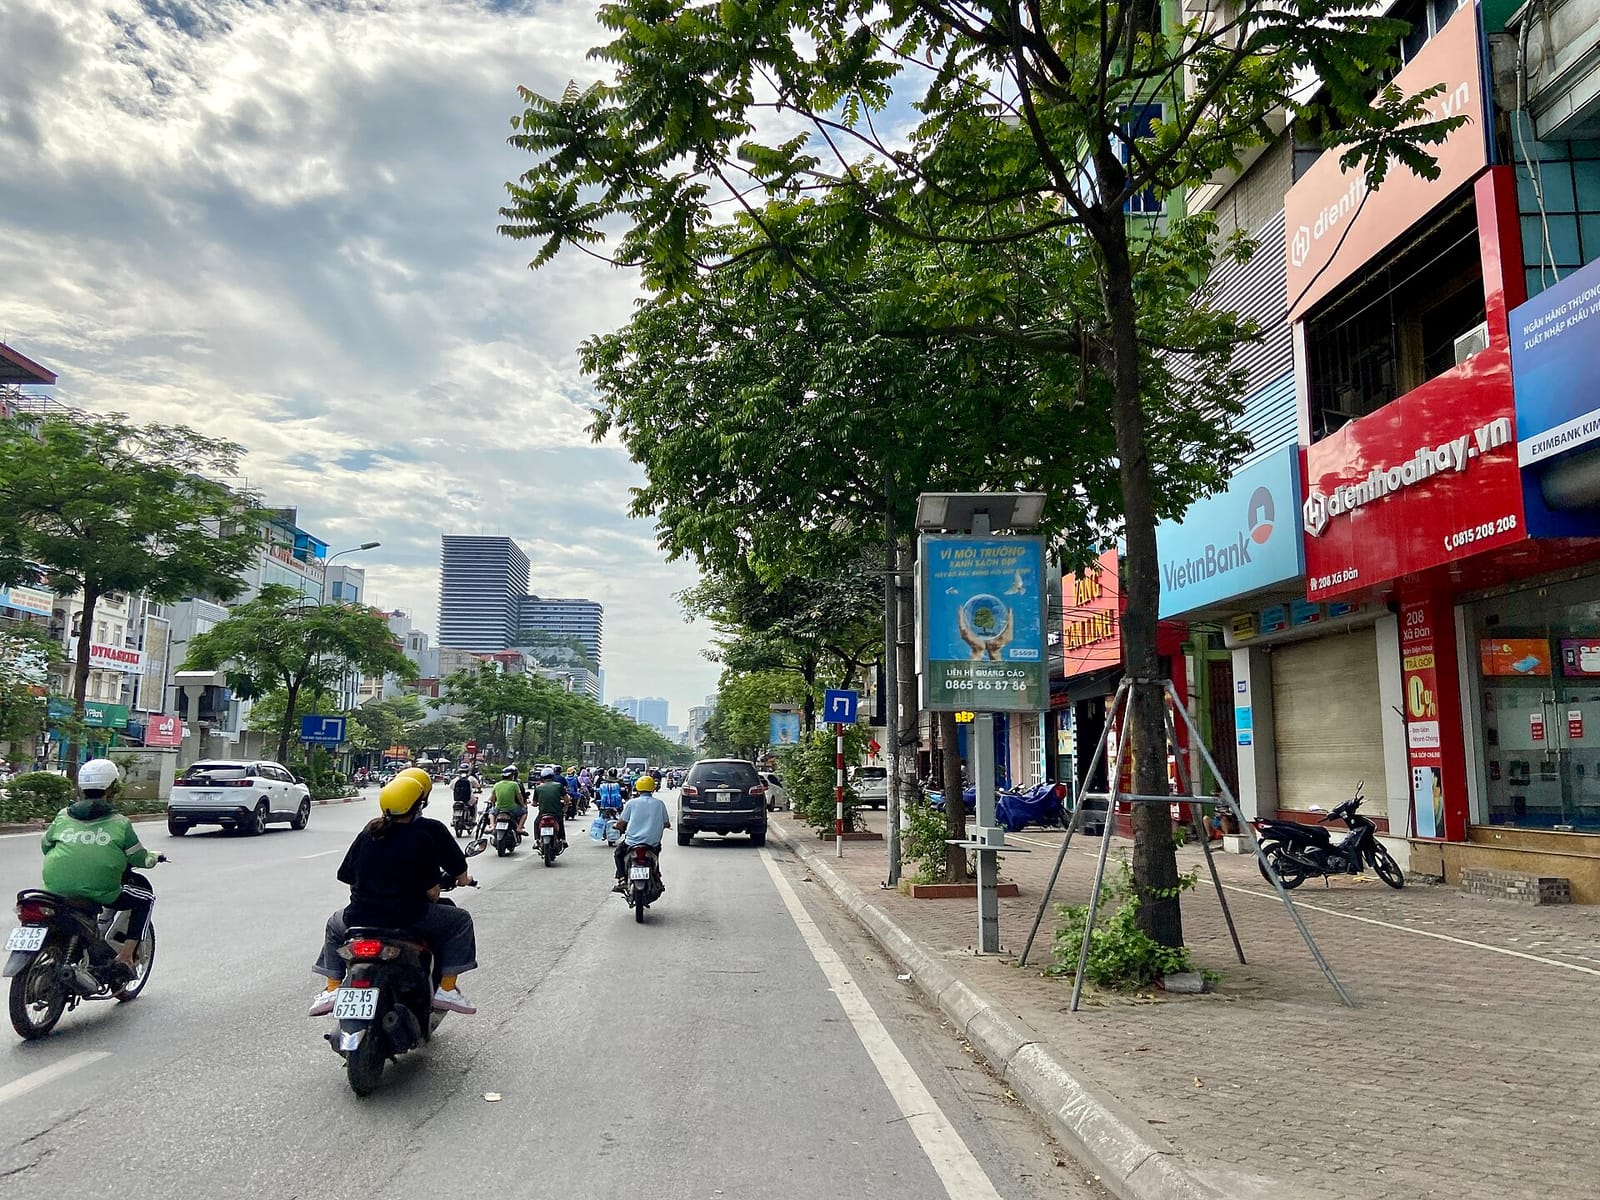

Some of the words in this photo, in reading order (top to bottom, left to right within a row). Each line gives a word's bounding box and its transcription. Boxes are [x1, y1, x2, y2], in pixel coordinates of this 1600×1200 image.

[1545, 304, 1567, 324] HÀNG
[1532, 427, 1581, 455] EXIMBANK
[1328, 417, 1512, 516] dienthoaihay.vn
[1452, 528, 1474, 547] 0815
[1475, 521, 1495, 540] 208
[1496, 514, 1517, 533] 208
[1163, 531, 1252, 592] VietinBank
[1318, 575, 1331, 590] 208
[1343, 566, 1358, 581] Đàn
[1406, 610, 1425, 626] 208
[1414, 625, 1430, 639] Đàn
[946, 668, 962, 676] LIÊN
[1006, 668, 1025, 677] CÁO
[945, 680, 974, 690] 0865
[977, 680, 991, 690] 86
[994, 680, 1008, 690] 87
[1012, 681, 1027, 691] 86
[1408, 675, 1436, 718] 0%
[60, 827, 111, 846] Grab
[342, 990, 373, 1003] 29-X5
[336, 1003, 373, 1017] 675.13
